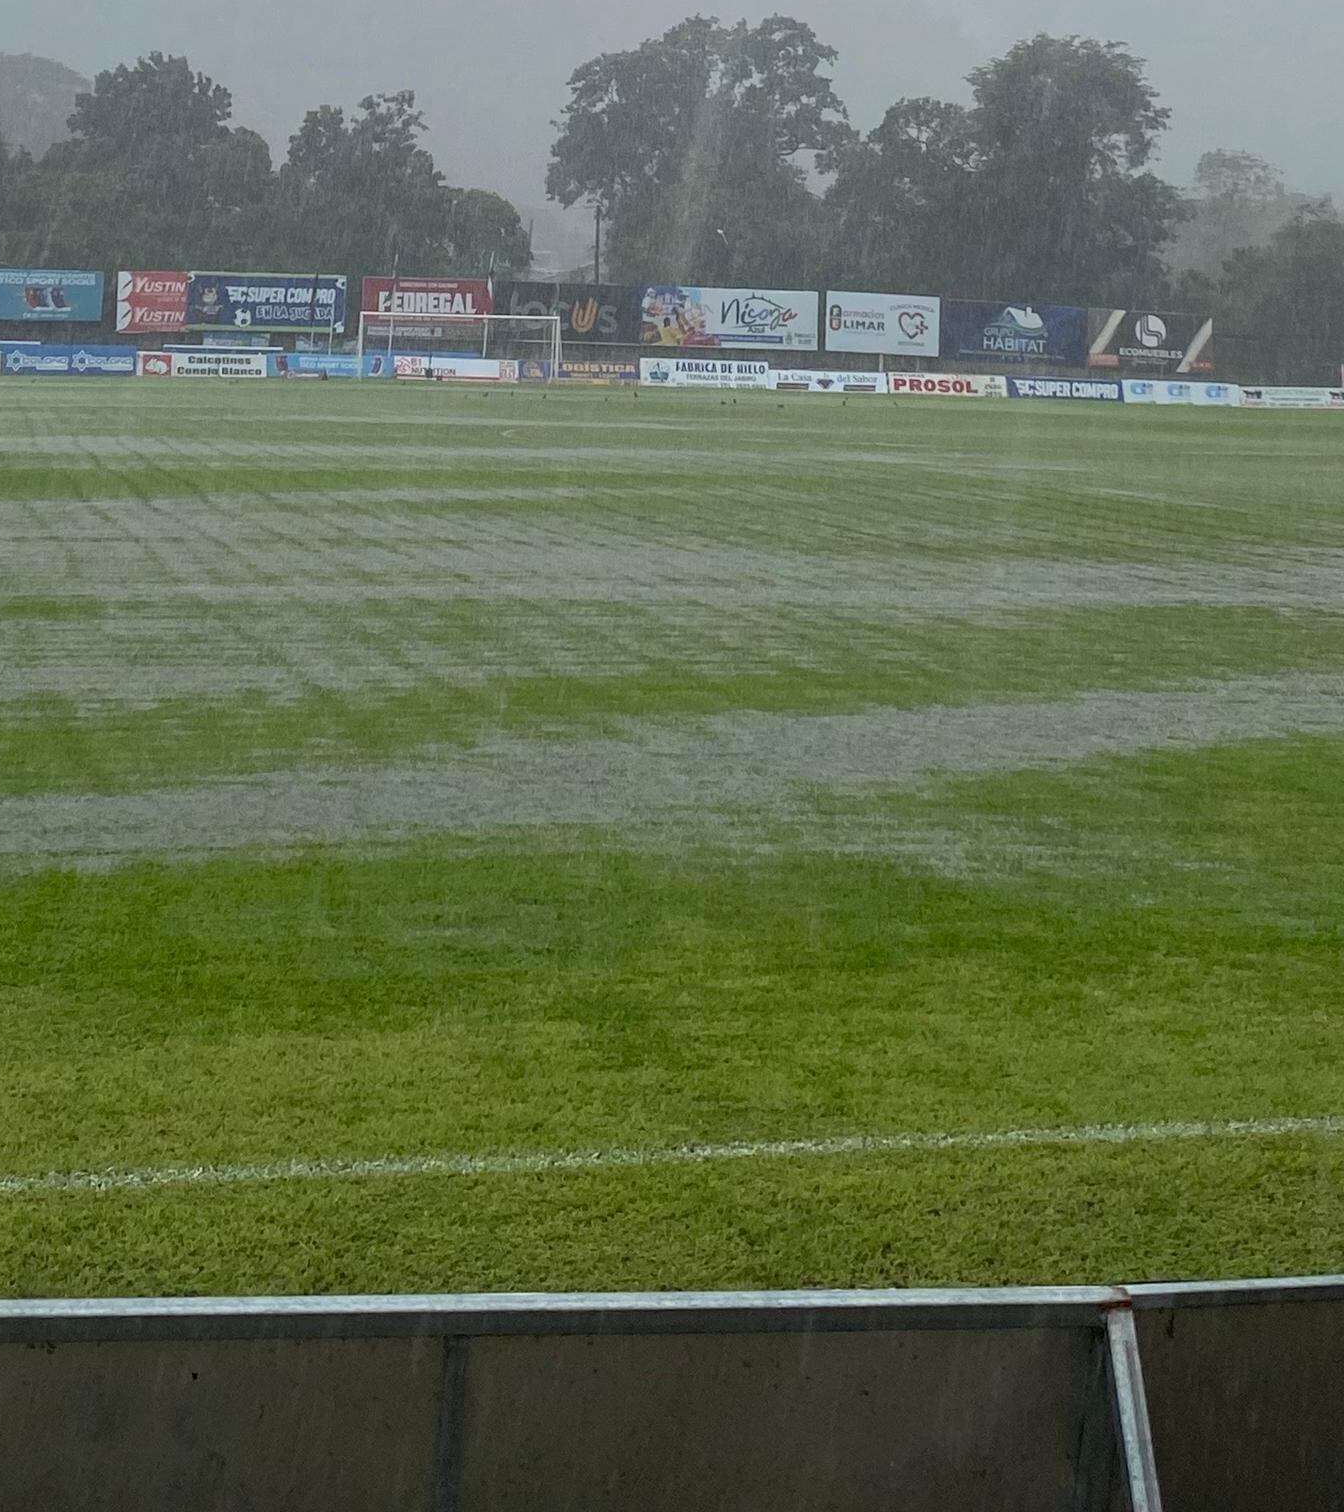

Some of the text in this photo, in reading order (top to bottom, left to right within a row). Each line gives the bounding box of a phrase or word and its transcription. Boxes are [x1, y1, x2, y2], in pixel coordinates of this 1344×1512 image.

[135, 276, 186, 293] YUSTIN
[247, 286, 286, 303] SUPER
[286, 287, 336, 304] COMPRO
[378, 291, 478, 314] PEDREGAL
[135, 306, 186, 323] YUSTIN
[255, 304, 273, 320] EN
[272, 304, 288, 320] LA
[721, 297, 798, 331] Nicoya
[1119, 347, 1184, 360] ECOMUEBLES
[176, 366, 263, 377] Conejo Blanco
[410, 367, 457, 377] NUTITION
[675, 361, 718, 373] FABRICA
[720, 362, 734, 374] DE
[778, 372, 813, 382] La Casa
[836, 374, 878, 384] del Sabor
[893, 377, 978, 394] PROSOL
[1034, 380, 1072, 398] SUPER
[1071, 382, 1119, 400] COMPRO
